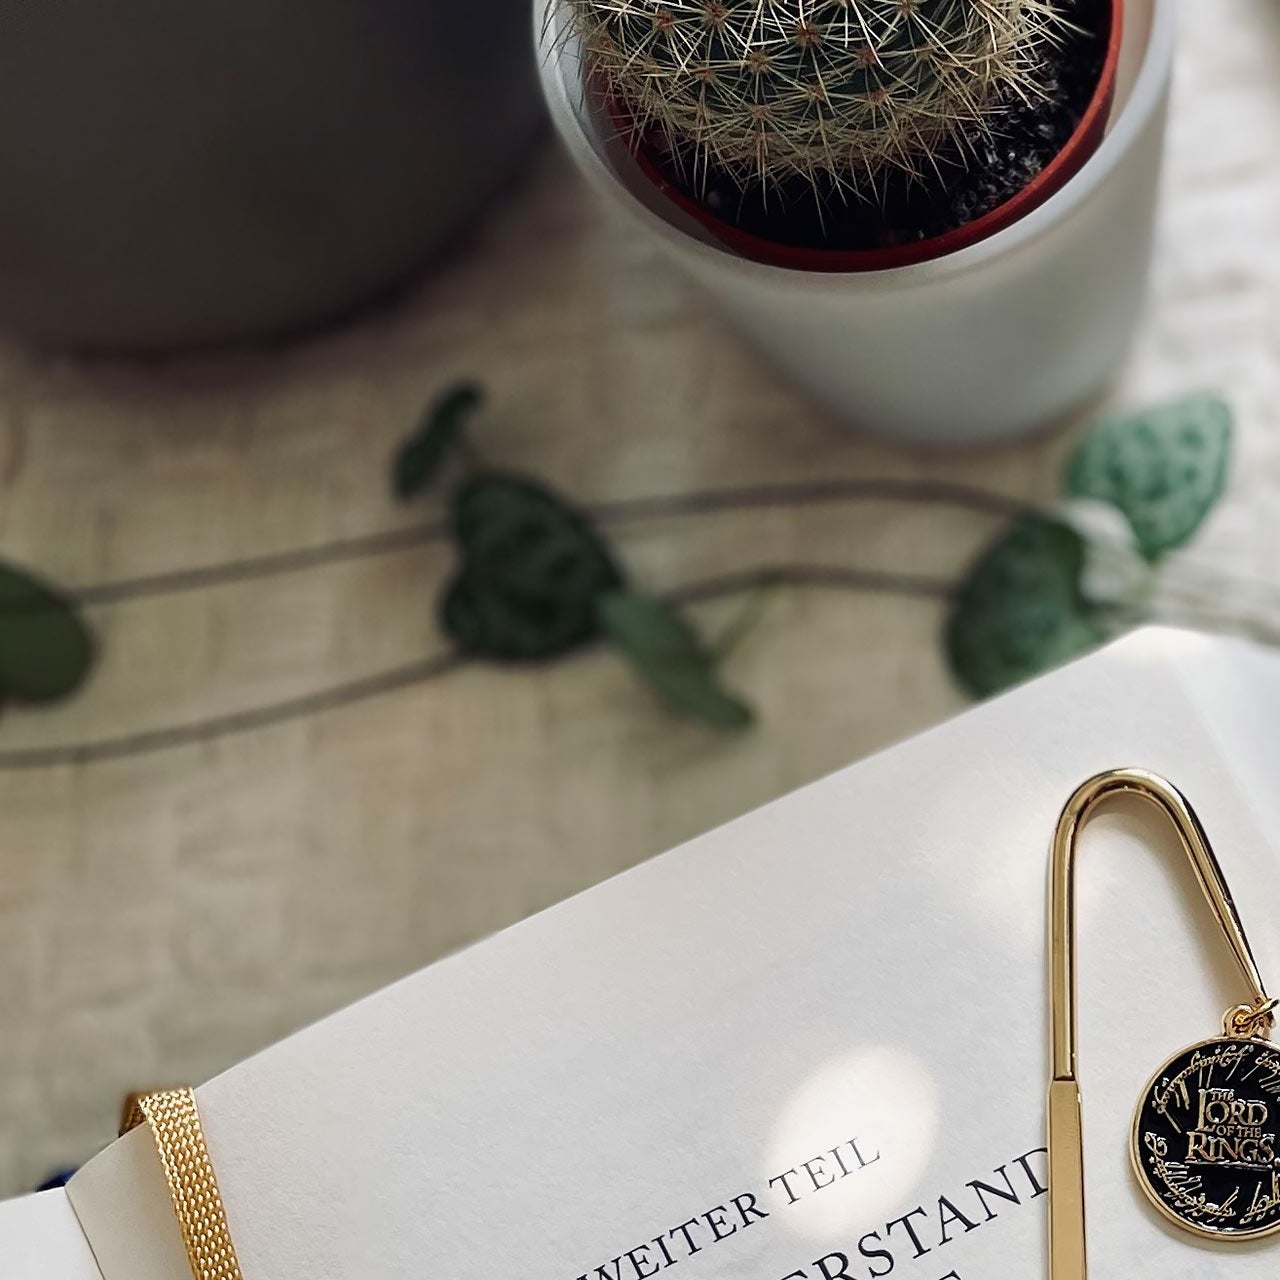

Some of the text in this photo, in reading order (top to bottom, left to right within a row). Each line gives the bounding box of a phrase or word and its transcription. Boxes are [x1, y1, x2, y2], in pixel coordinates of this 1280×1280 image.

[1195, 1088, 1268, 1132] LORD
[1211, 1089, 1235, 1102] THE
[1184, 1131, 1275, 1164] RINGS
[1216, 1125, 1262, 1138] OF THE
[769, 1137, 882, 1205] TEIL
